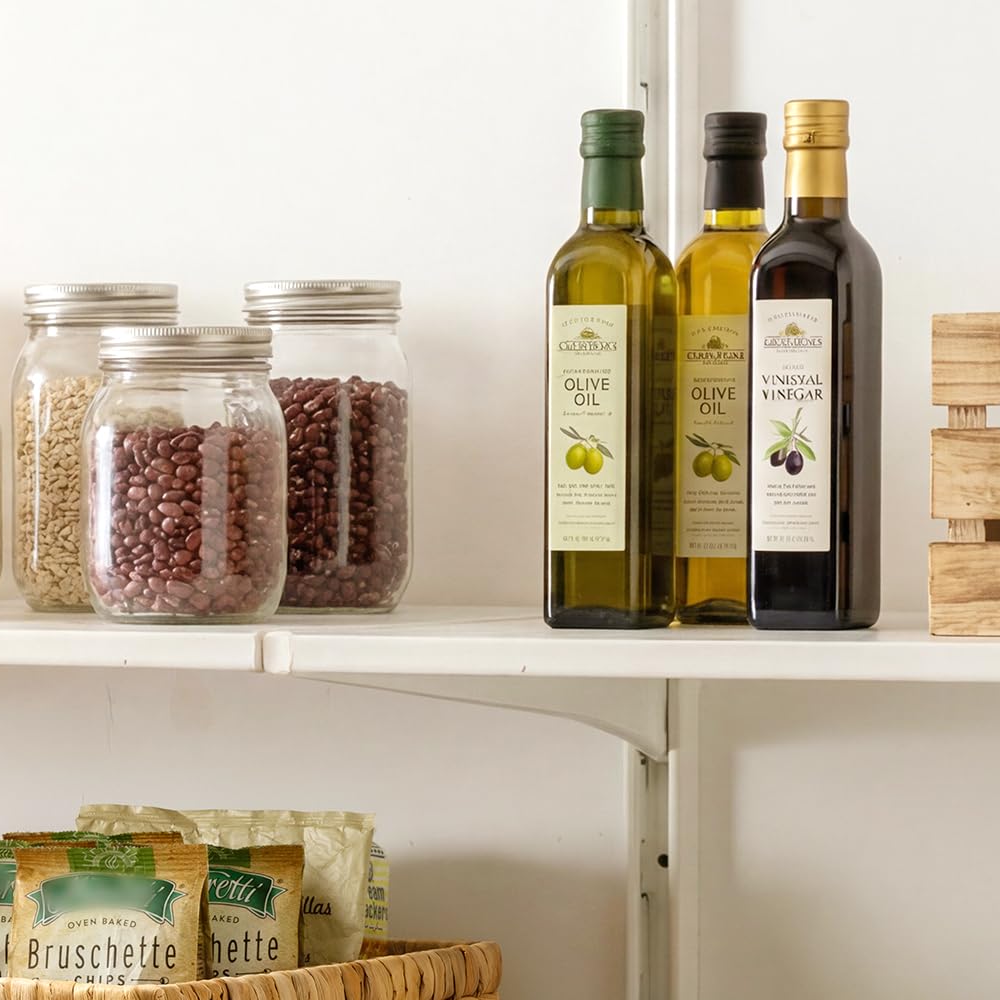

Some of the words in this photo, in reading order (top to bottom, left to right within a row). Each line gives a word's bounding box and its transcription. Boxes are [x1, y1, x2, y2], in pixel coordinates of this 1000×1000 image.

[564, 377, 610, 392] OLIVE
[574, 393, 600, 407] OIL
[691, 386, 736, 401] OLIVE
[761, 388, 824, 401] VINEGAR
[700, 401, 726, 415] OIL
[67, 917, 98, 930] OVEN
[102, 917, 137, 929] BAKED
[211, 914, 240, 924] AKED
[27, 935, 177, 970] Bruschette
[211, 929, 279, 964] hette
[74, 974, 127, 986] CHIPS
